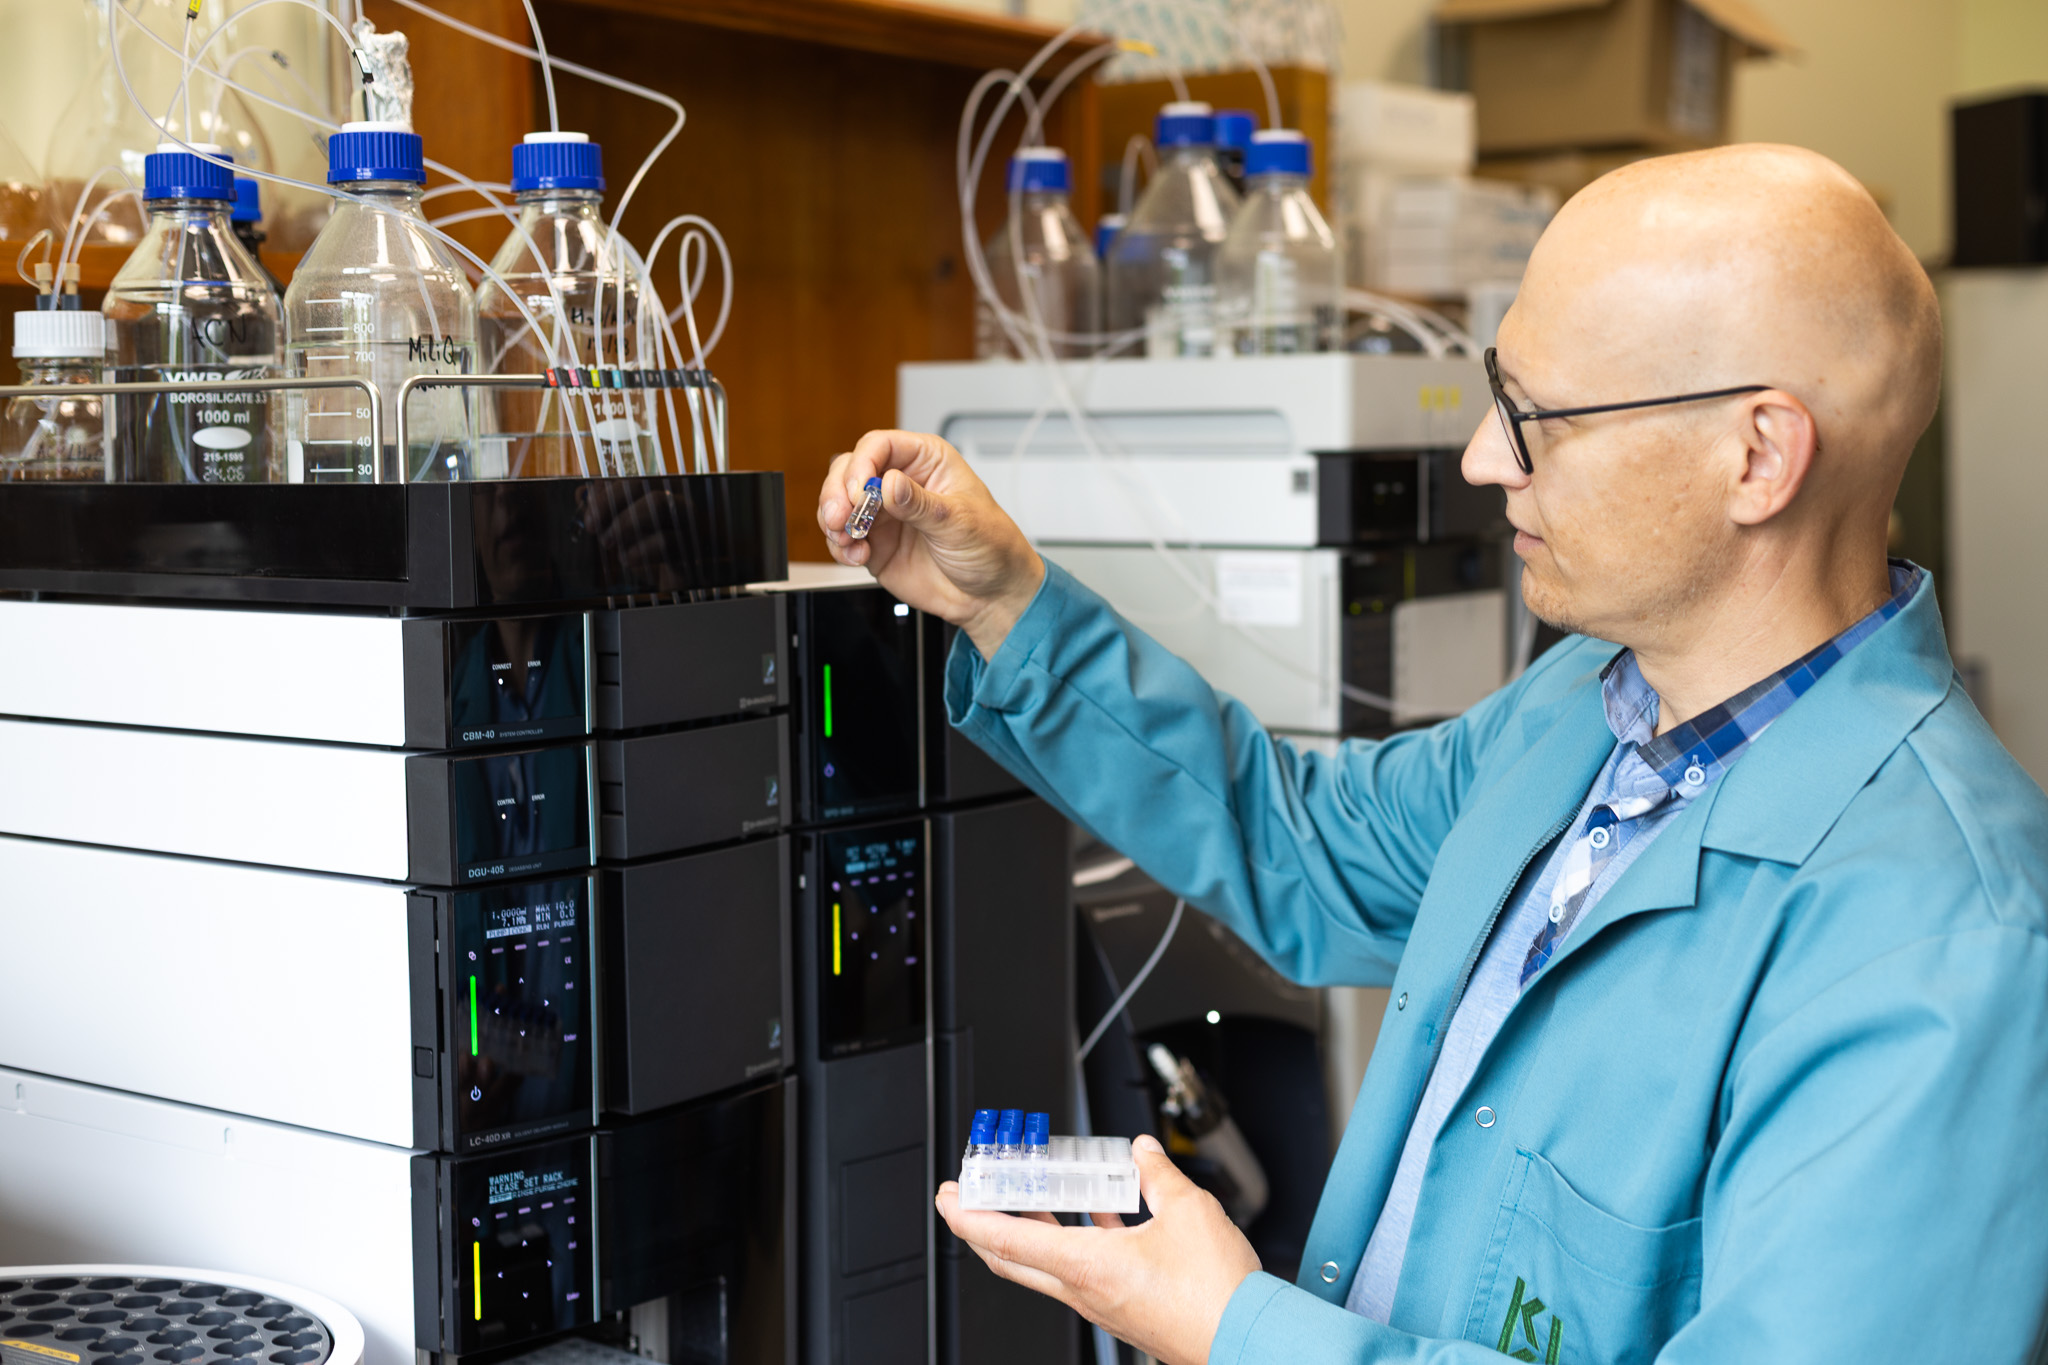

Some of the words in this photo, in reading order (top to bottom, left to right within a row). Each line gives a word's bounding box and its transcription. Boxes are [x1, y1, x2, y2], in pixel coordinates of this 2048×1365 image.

[191, 314, 248, 348] ACN
[353, 323, 375, 333] 800
[355, 352, 376, 362] 700
[170, 393, 252, 403] BOROSILICATE
[196, 410, 230, 424] 1000
[234, 410, 250, 424] ml
[356, 408, 371, 419] 50
[357, 437, 371, 447] 40
[357, 464, 372, 475] 30
[463, 730, 495, 741] CBM-40
[497, 798, 516, 806] CONTROL
[536, 903, 551, 912] MAX
[556, 900, 575, 911] 10.0
[536, 912, 551, 922] MIN
[560, 908, 575, 919] 0.0
[536, 923, 550, 931] RUN
[554, 918, 575, 928] PURGE
[469, 1133, 500, 1147] LC-40D
[489, 1170, 525, 1185] WARNING
[489, 1180, 520, 1195] PLEASE
[524, 1175, 539, 1188] SET
[543, 1170, 563, 1183] RACK
